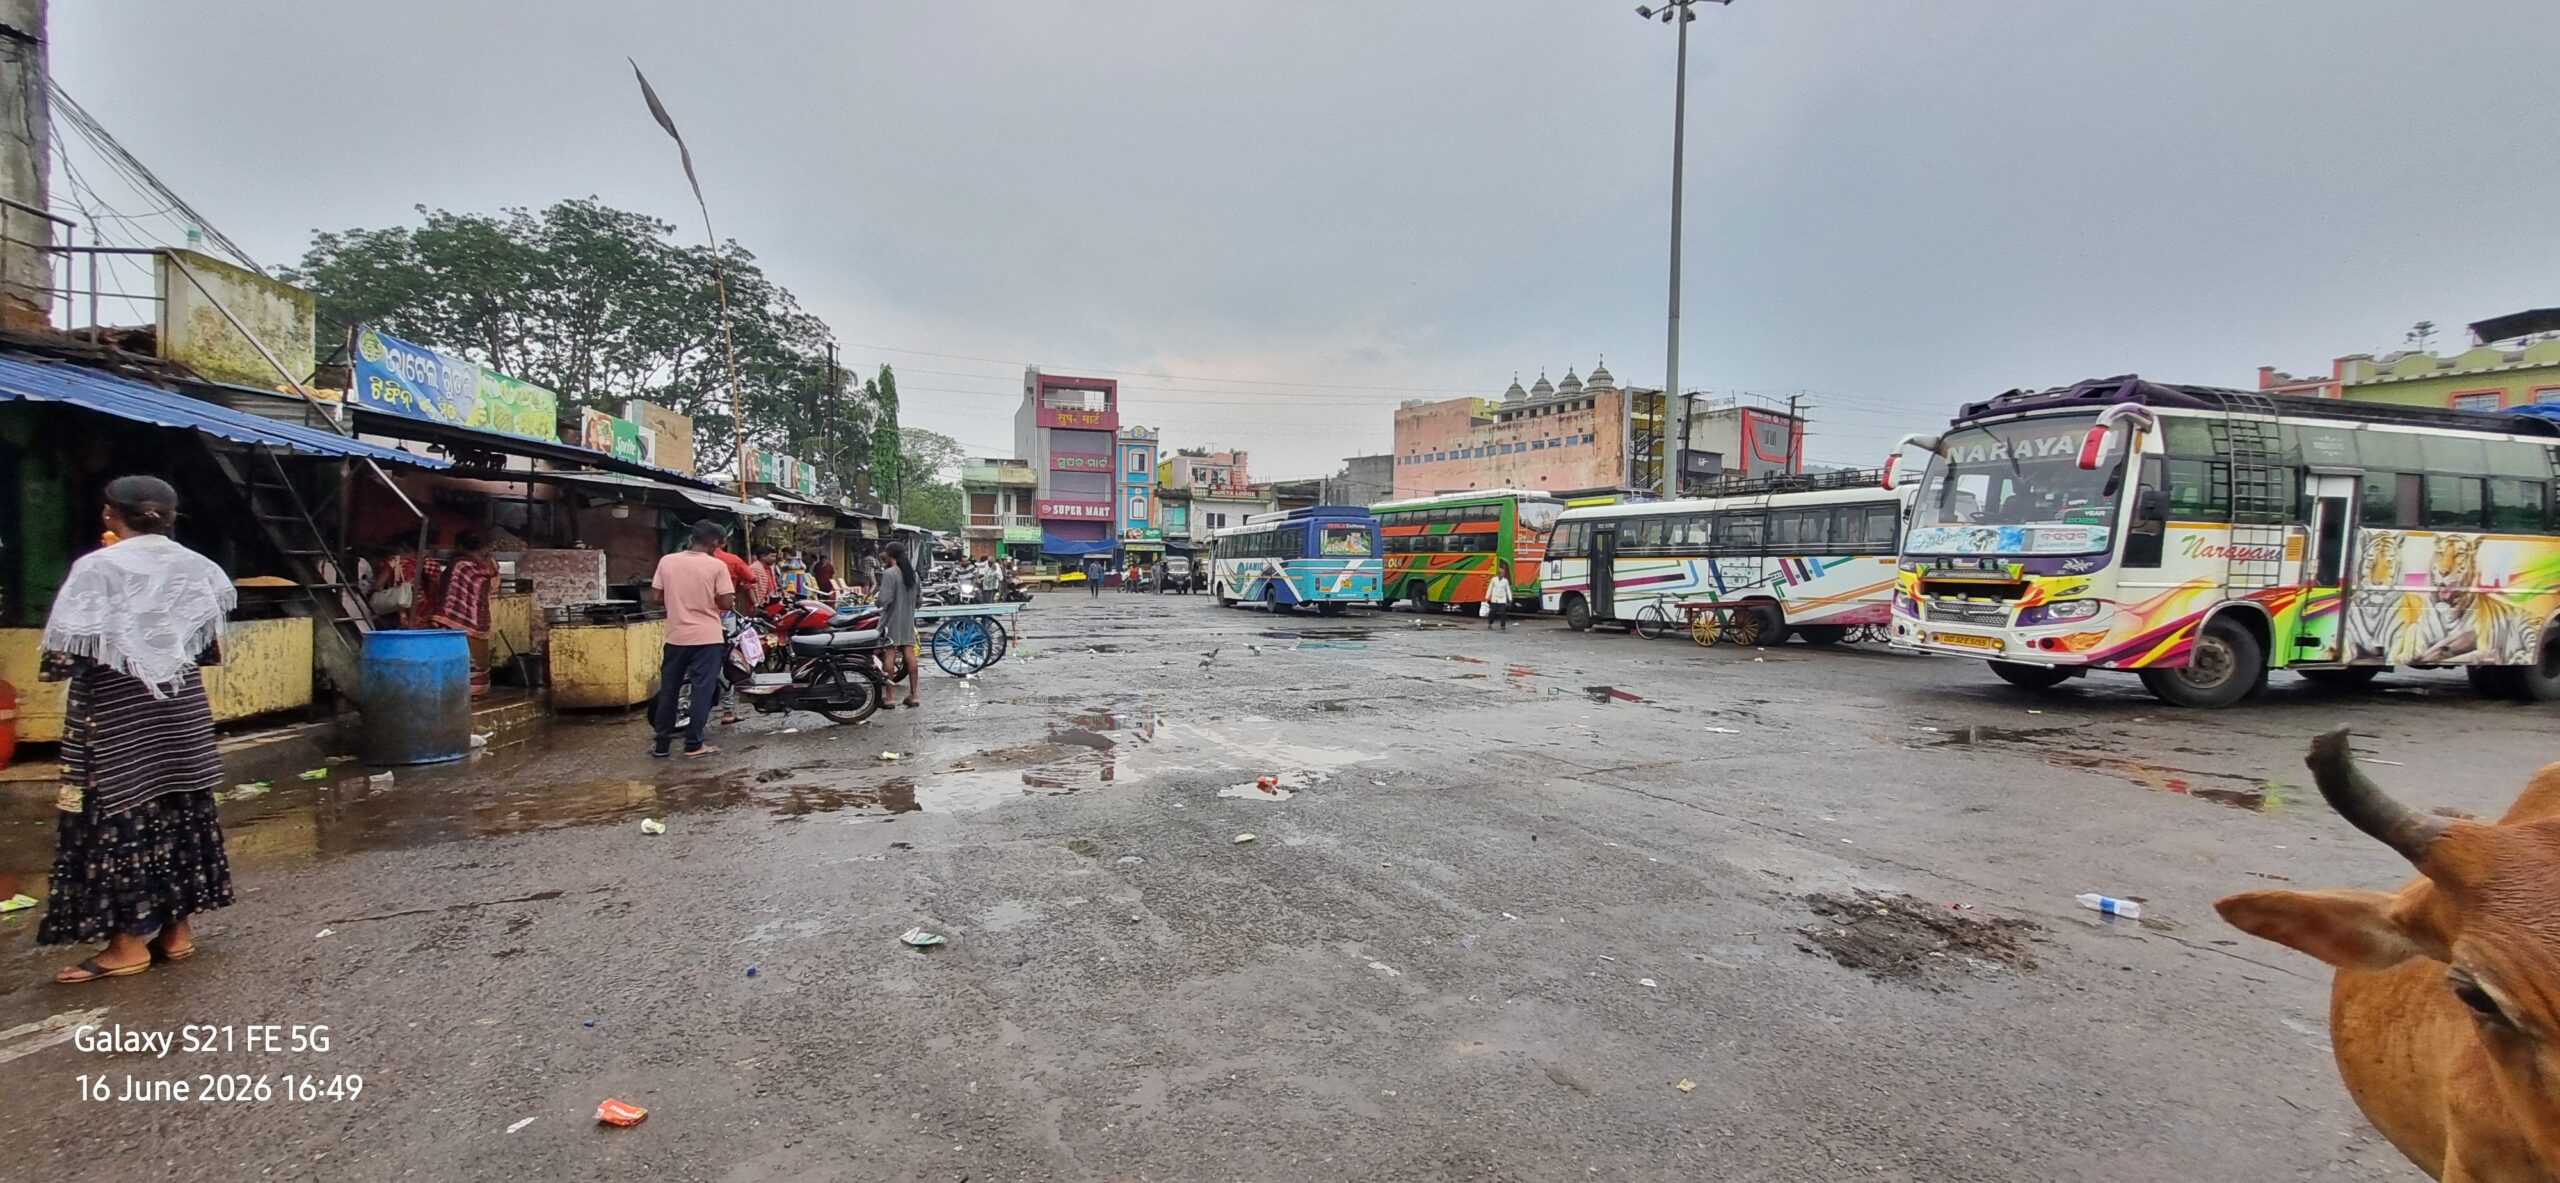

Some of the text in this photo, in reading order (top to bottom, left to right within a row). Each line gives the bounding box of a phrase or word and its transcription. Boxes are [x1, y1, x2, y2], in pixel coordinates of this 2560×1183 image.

[616, 435, 637, 456] Sprite
[1053, 504, 1111, 517] SUPER MART
